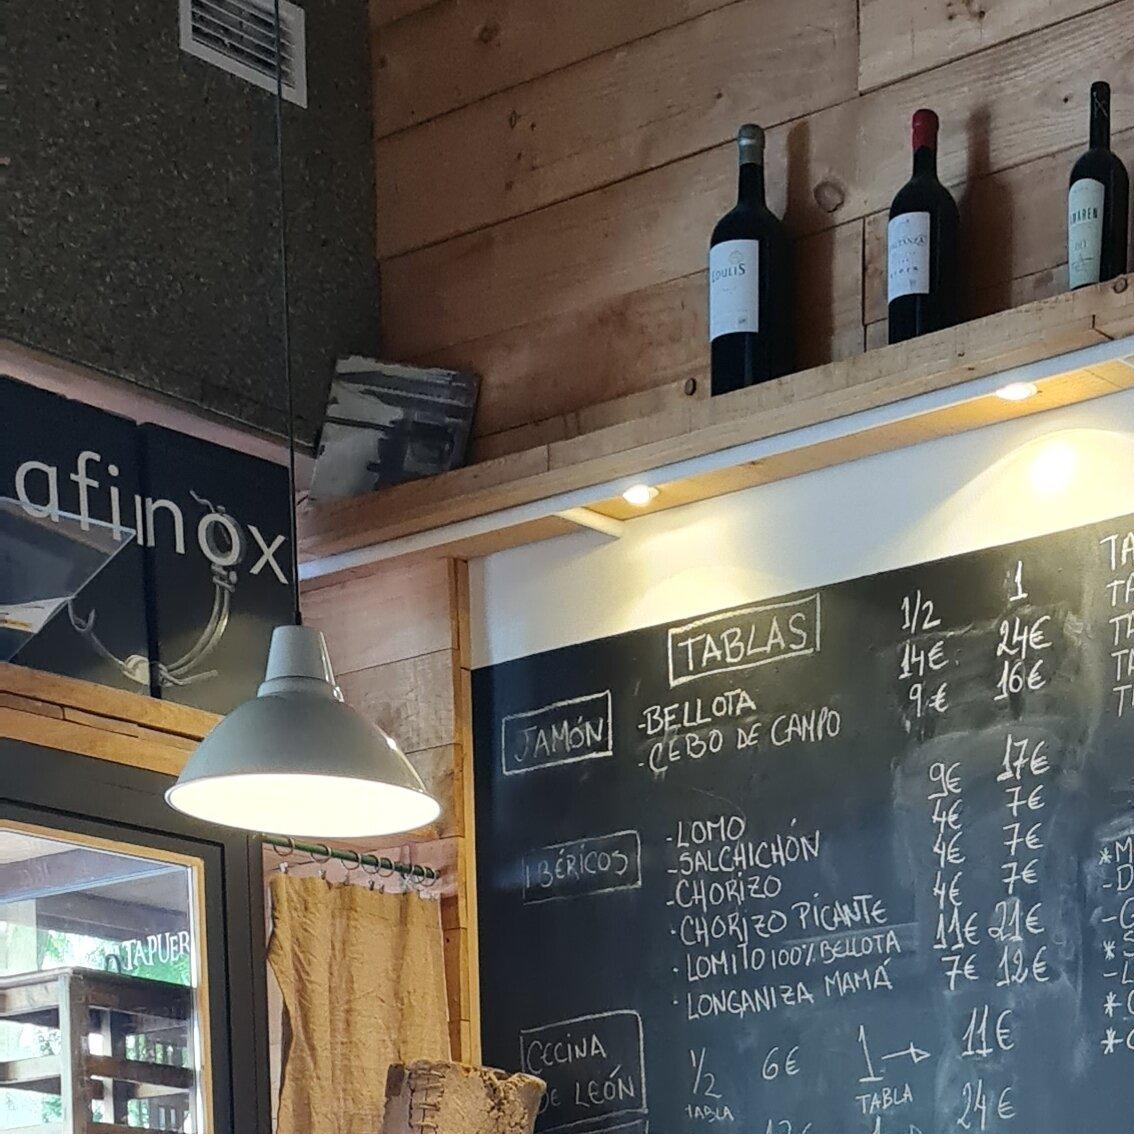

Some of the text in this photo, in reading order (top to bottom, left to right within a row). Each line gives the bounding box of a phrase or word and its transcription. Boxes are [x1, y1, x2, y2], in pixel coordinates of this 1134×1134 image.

[14, 450, 290, 586] afinox
[1009, 560, 1028, 601] 1
[901, 589, 941, 634] 1/2
[676, 612, 808, 671] TABLAS
[898, 615, 1053, 680] 14€ 24€
[993, 659, 1047, 701] 16€
[513, 715, 604, 762] JAMÓN
[736, 725, 762, 751] DE
[770, 707, 842, 746] CAMPO
[996, 733, 1051, 782] 17€
[524, 843, 629, 889] IBÉRICOS
[680, 911, 788, 947] CHORIZO
[791, 892, 889, 934] PICANTE
[687, 942, 766, 982] LOMITO
[819, 929, 902, 965] BELLOTA
[686, 980, 814, 1020] LONGANIZA
[824, 956, 894, 998] MAMÁ
[526, 1033, 607, 1076] CECINA
[575, 1064, 635, 1108] LEÓN
[683, 1083, 914, 1123] TABLA TABLA
[956, 1078, 1017, 1132] 24€
